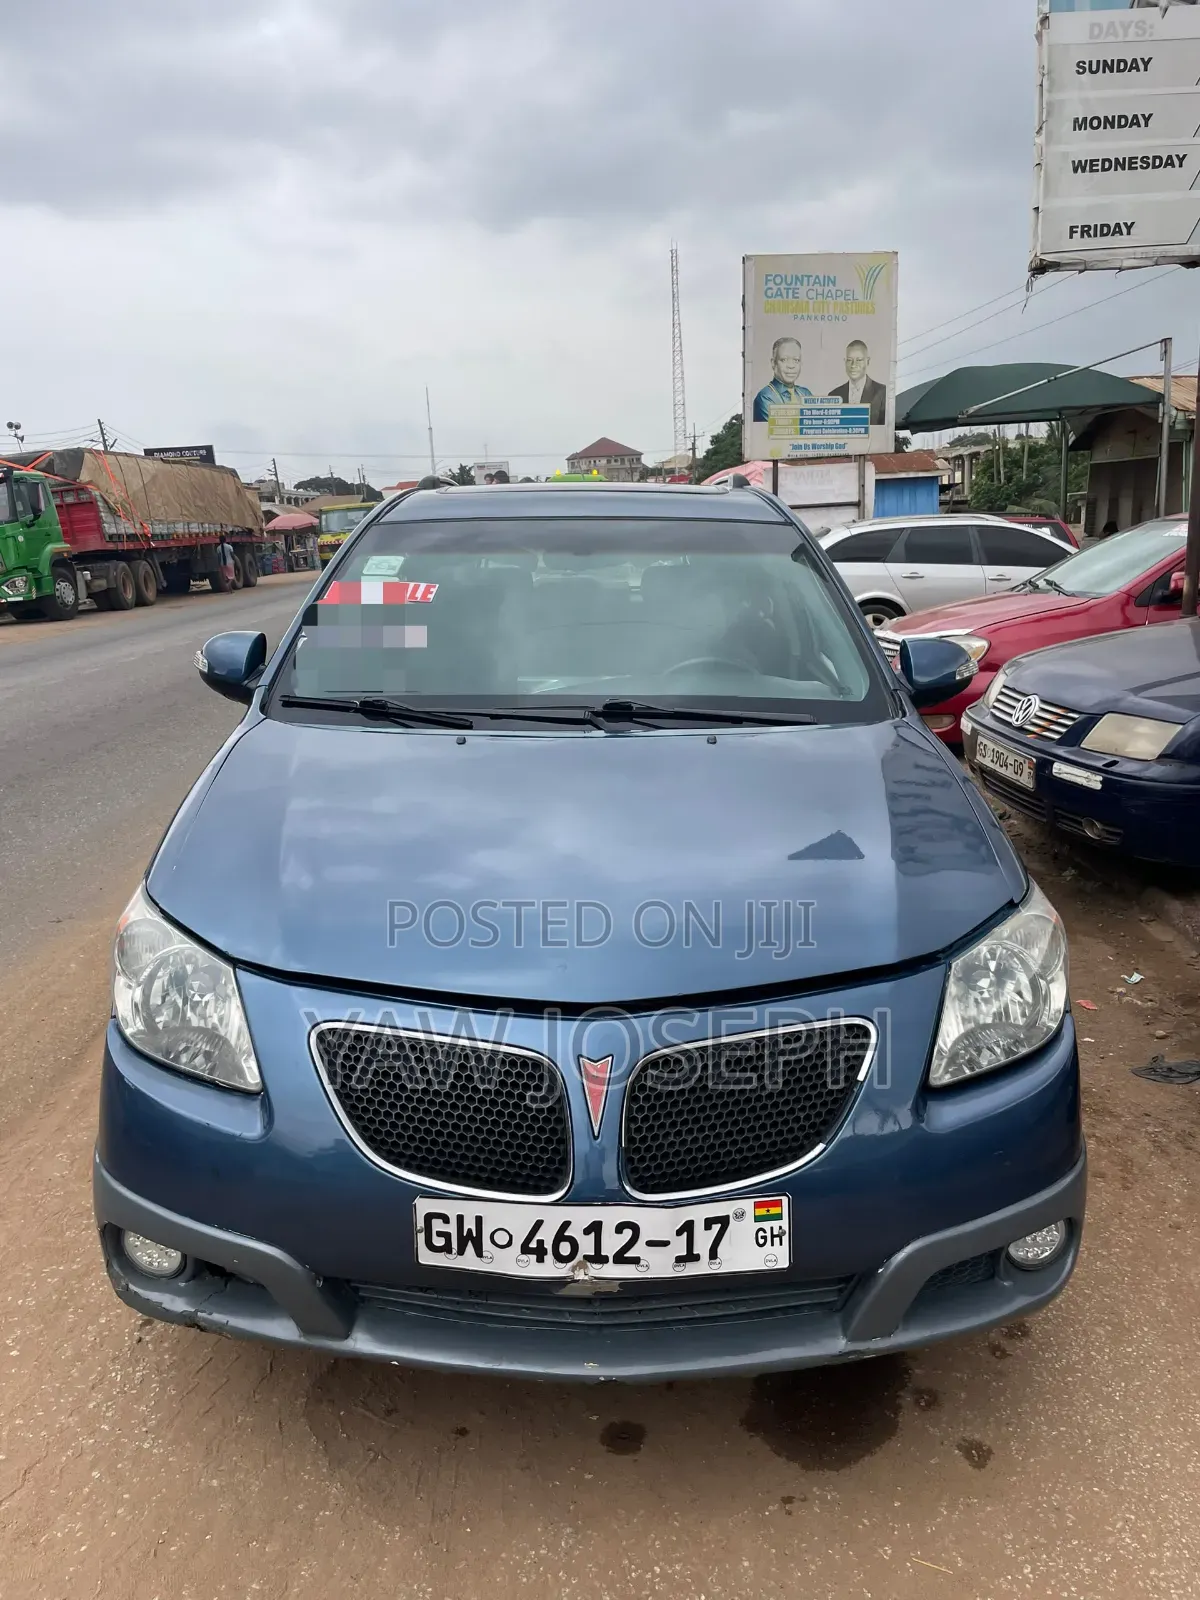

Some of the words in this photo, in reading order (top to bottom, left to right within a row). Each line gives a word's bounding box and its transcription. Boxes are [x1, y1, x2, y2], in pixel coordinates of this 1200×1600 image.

[1089, 20, 1155, 40] DAYS:
[1075, 57, 1153, 76] SUNDAY
[1072, 113, 1154, 132] MONDAY
[1071, 153, 1188, 174] WEDNESDAY
[1068, 221, 1136, 240] FRIDAY
[764, 273, 836, 287] FOUNTAIN
[764, 287, 800, 300] GATE
[805, 288, 859, 301] CHAPEL
[793, 314, 848, 322] PANKRONO
[811, 442, 834, 451] Worship
[978, 741, 988, 758] GS
[990, 747, 1024, 777] 1904-09
[423, 1211, 484, 1258] GW
[519, 1214, 731, 1265] 4612-17
[754, 1225, 784, 1248] GH
